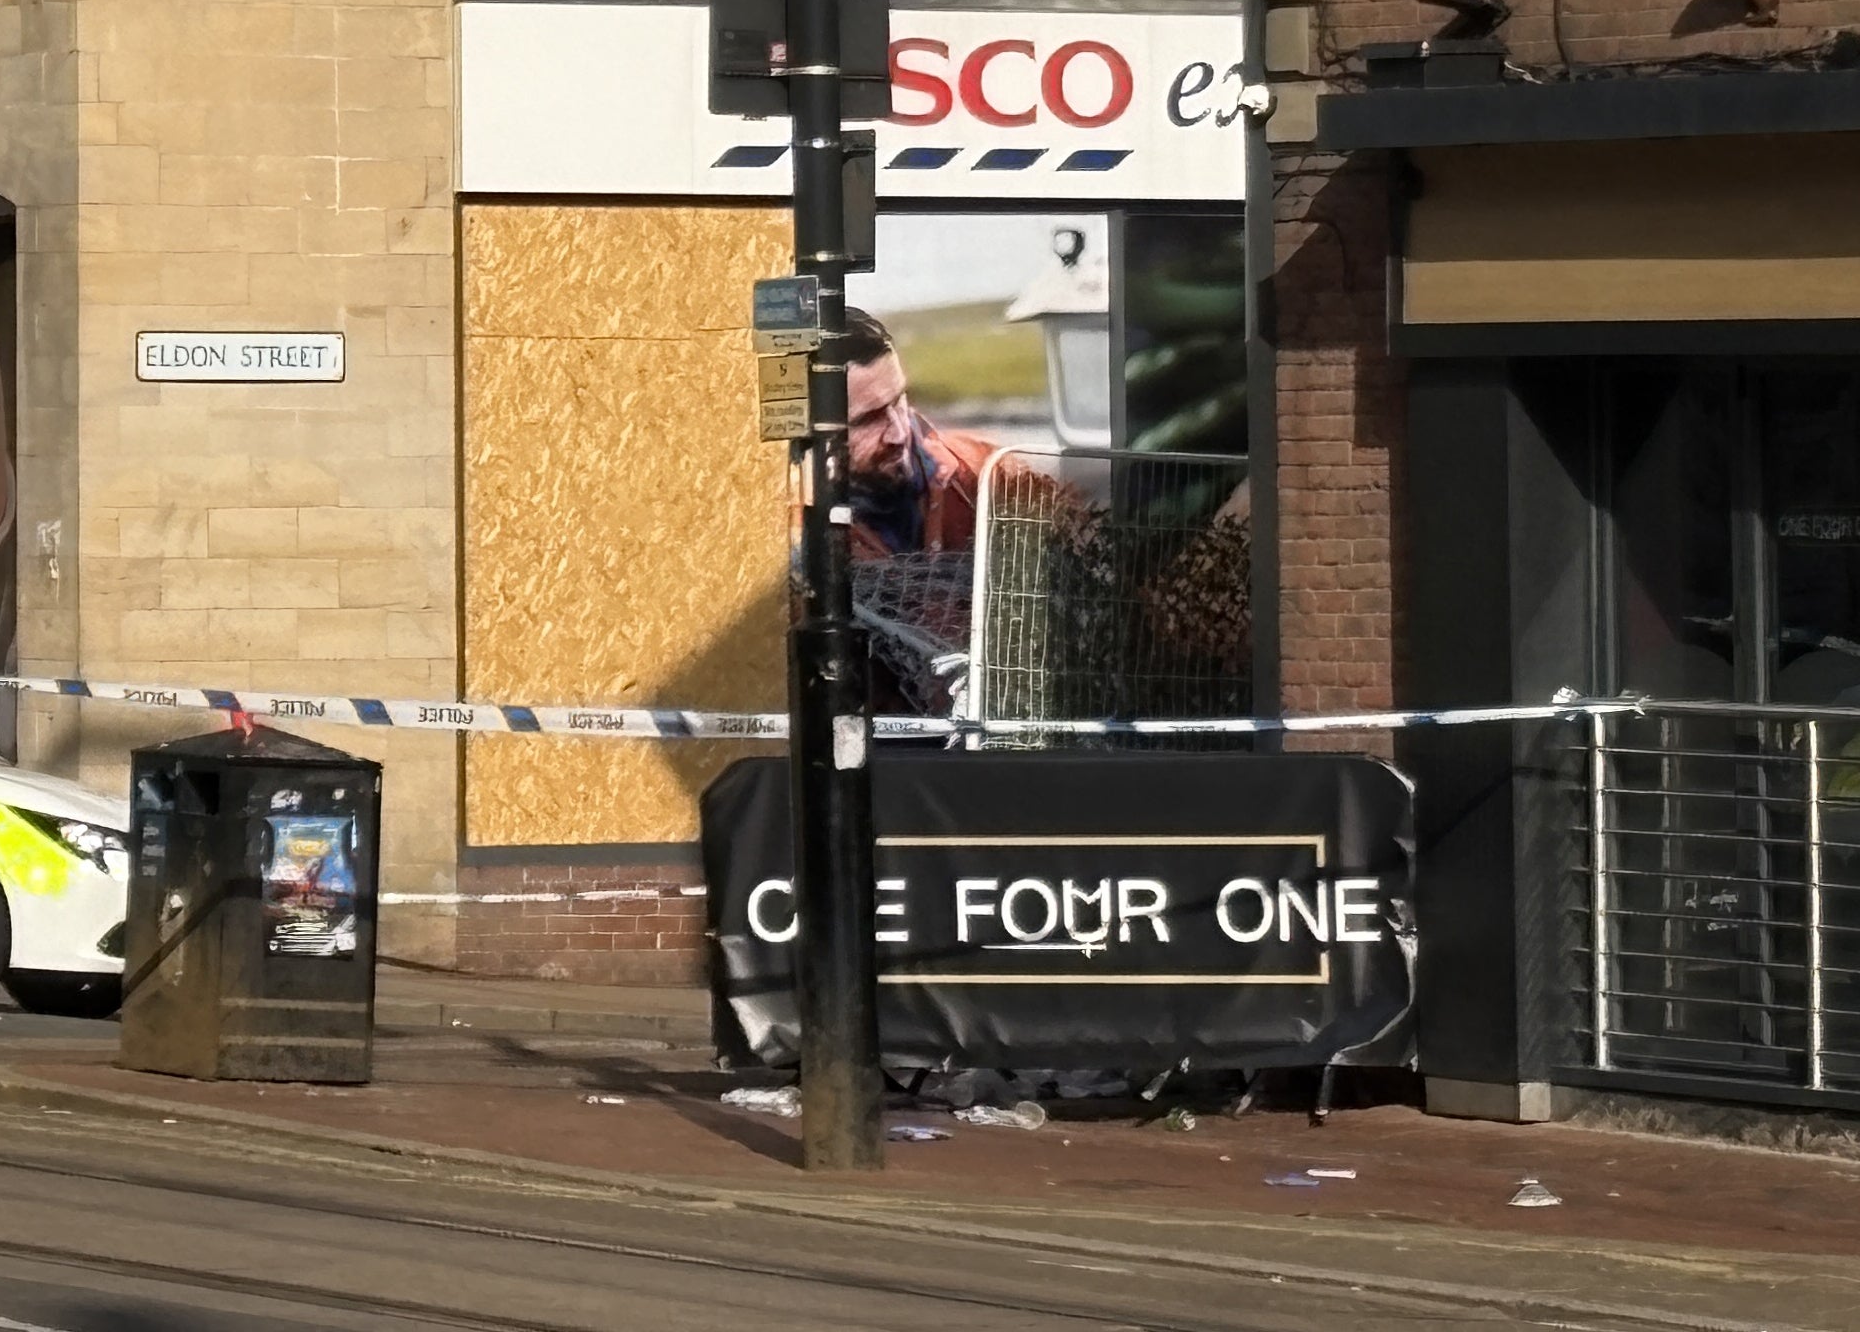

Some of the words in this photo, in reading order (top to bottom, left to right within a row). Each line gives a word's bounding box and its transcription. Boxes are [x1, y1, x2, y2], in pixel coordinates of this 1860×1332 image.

[887, 38, 1134, 128] SCO
[145, 344, 227, 367] ELDON
[240, 344, 329, 369] STREET
[747, 878, 907, 944] OE
[1215, 878, 1382, 943] ONE
